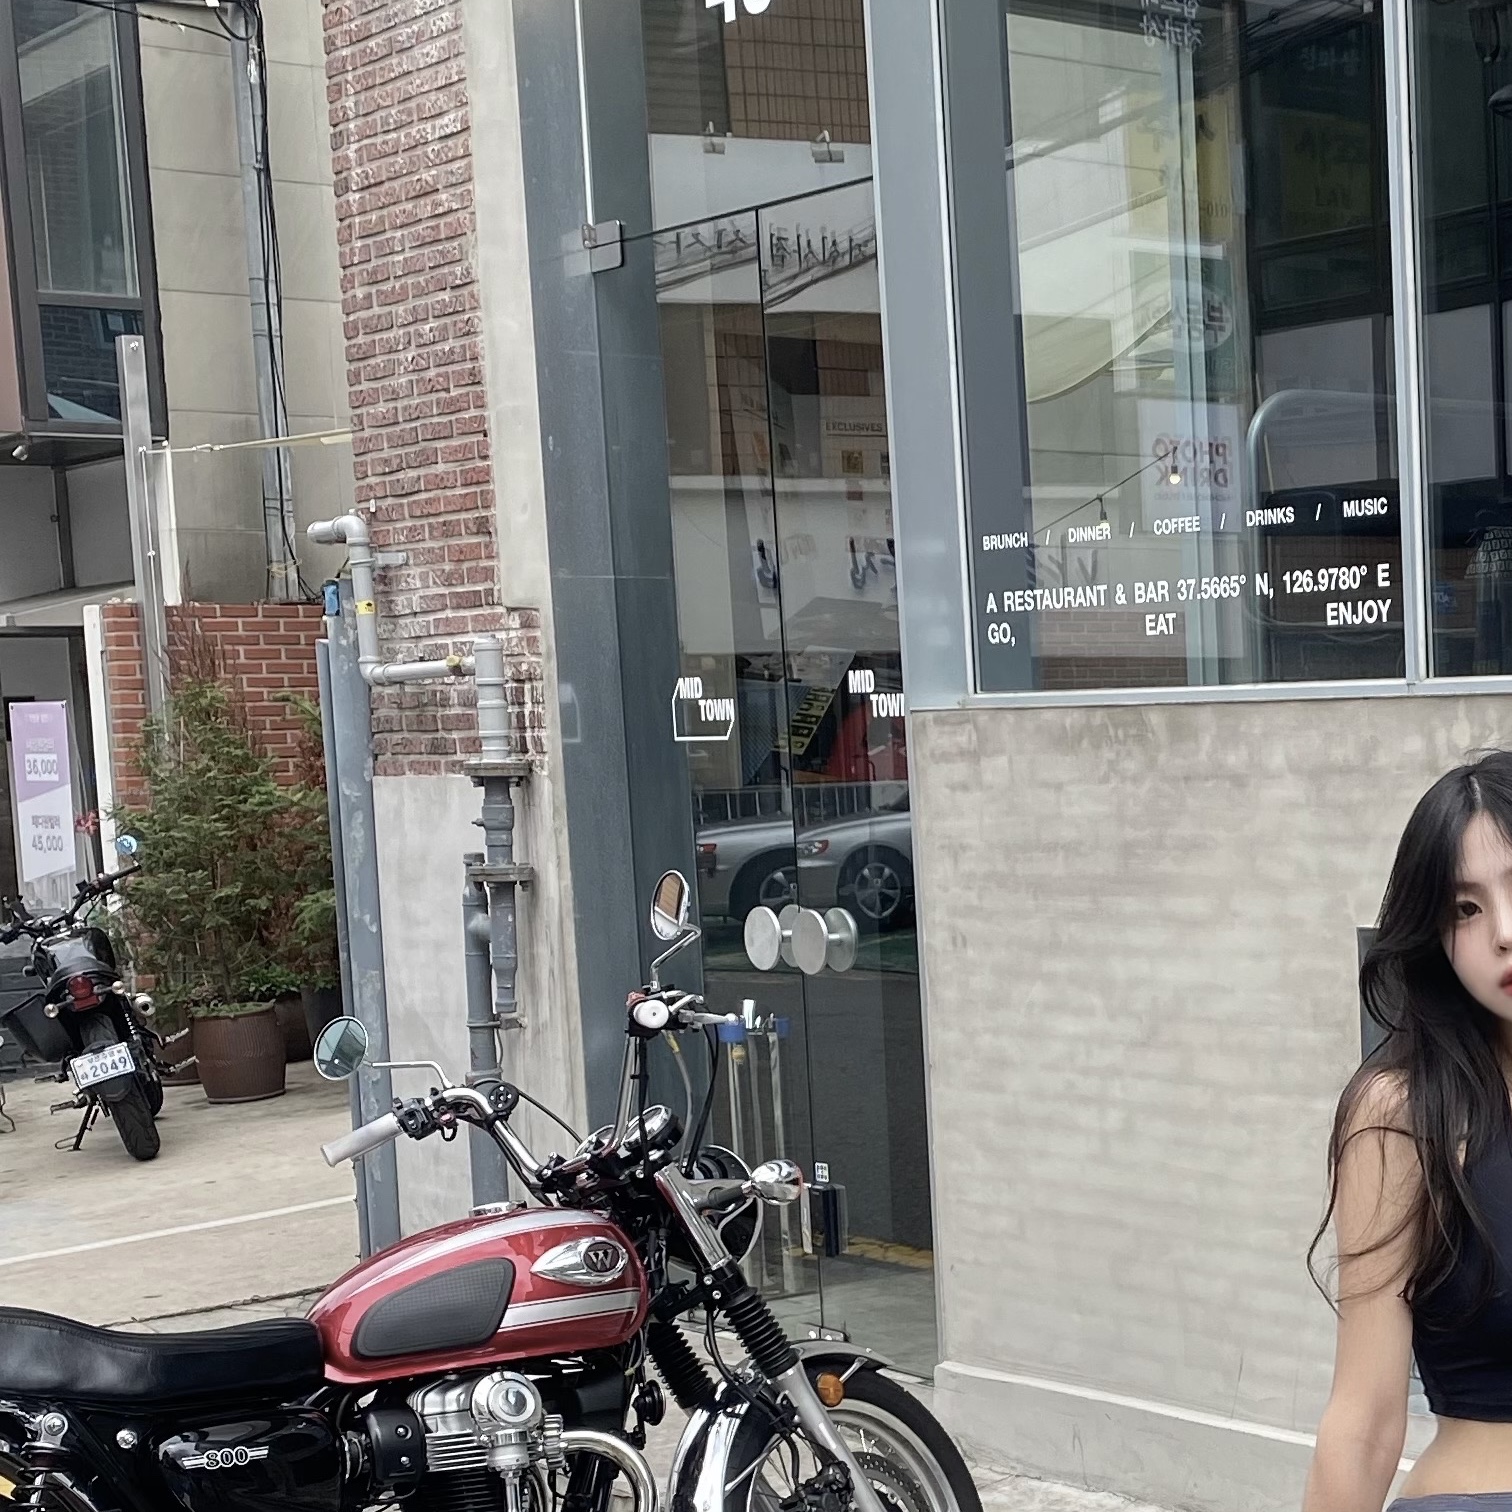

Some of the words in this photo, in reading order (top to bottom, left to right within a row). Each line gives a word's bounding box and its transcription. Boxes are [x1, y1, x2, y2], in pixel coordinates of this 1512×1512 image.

[825, 421, 884, 433] EXCLUSIVES
[982, 532, 1029, 551] BRUNCH
[1068, 522, 1112, 543] DINNER
[1153, 515, 1201, 536] COFFEE
[1245, 506, 1295, 527] DRINKS
[1343, 497, 1388, 518] MUSIC
[986, 592, 998, 614] A
[1003, 584, 1108, 612] RESTAURANT
[1115, 583, 1128, 605] &
[1134, 580, 1170, 604] BAR
[1176, 574, 1247, 601] 37.5665°
[1255, 573, 1274, 601] N,
[1282, 565, 1368, 595] 126.9780°
[1377, 563, 1391, 587] E
[987, 622, 1017, 648] GO,
[1145, 612, 1177, 637] EAT
[1326, 599, 1392, 626] ENJOY
[679, 676, 703, 699] MID
[848, 670, 875, 694] MID
[698, 699, 735, 722] TOWN
[26, 758, 59, 778] 36,000
[32, 835, 64, 854] 45,000
[90, 1056, 127, 1078] 2049
[587, 1247, 614, 1271] W
[204, 1445, 249, 1470] 800
